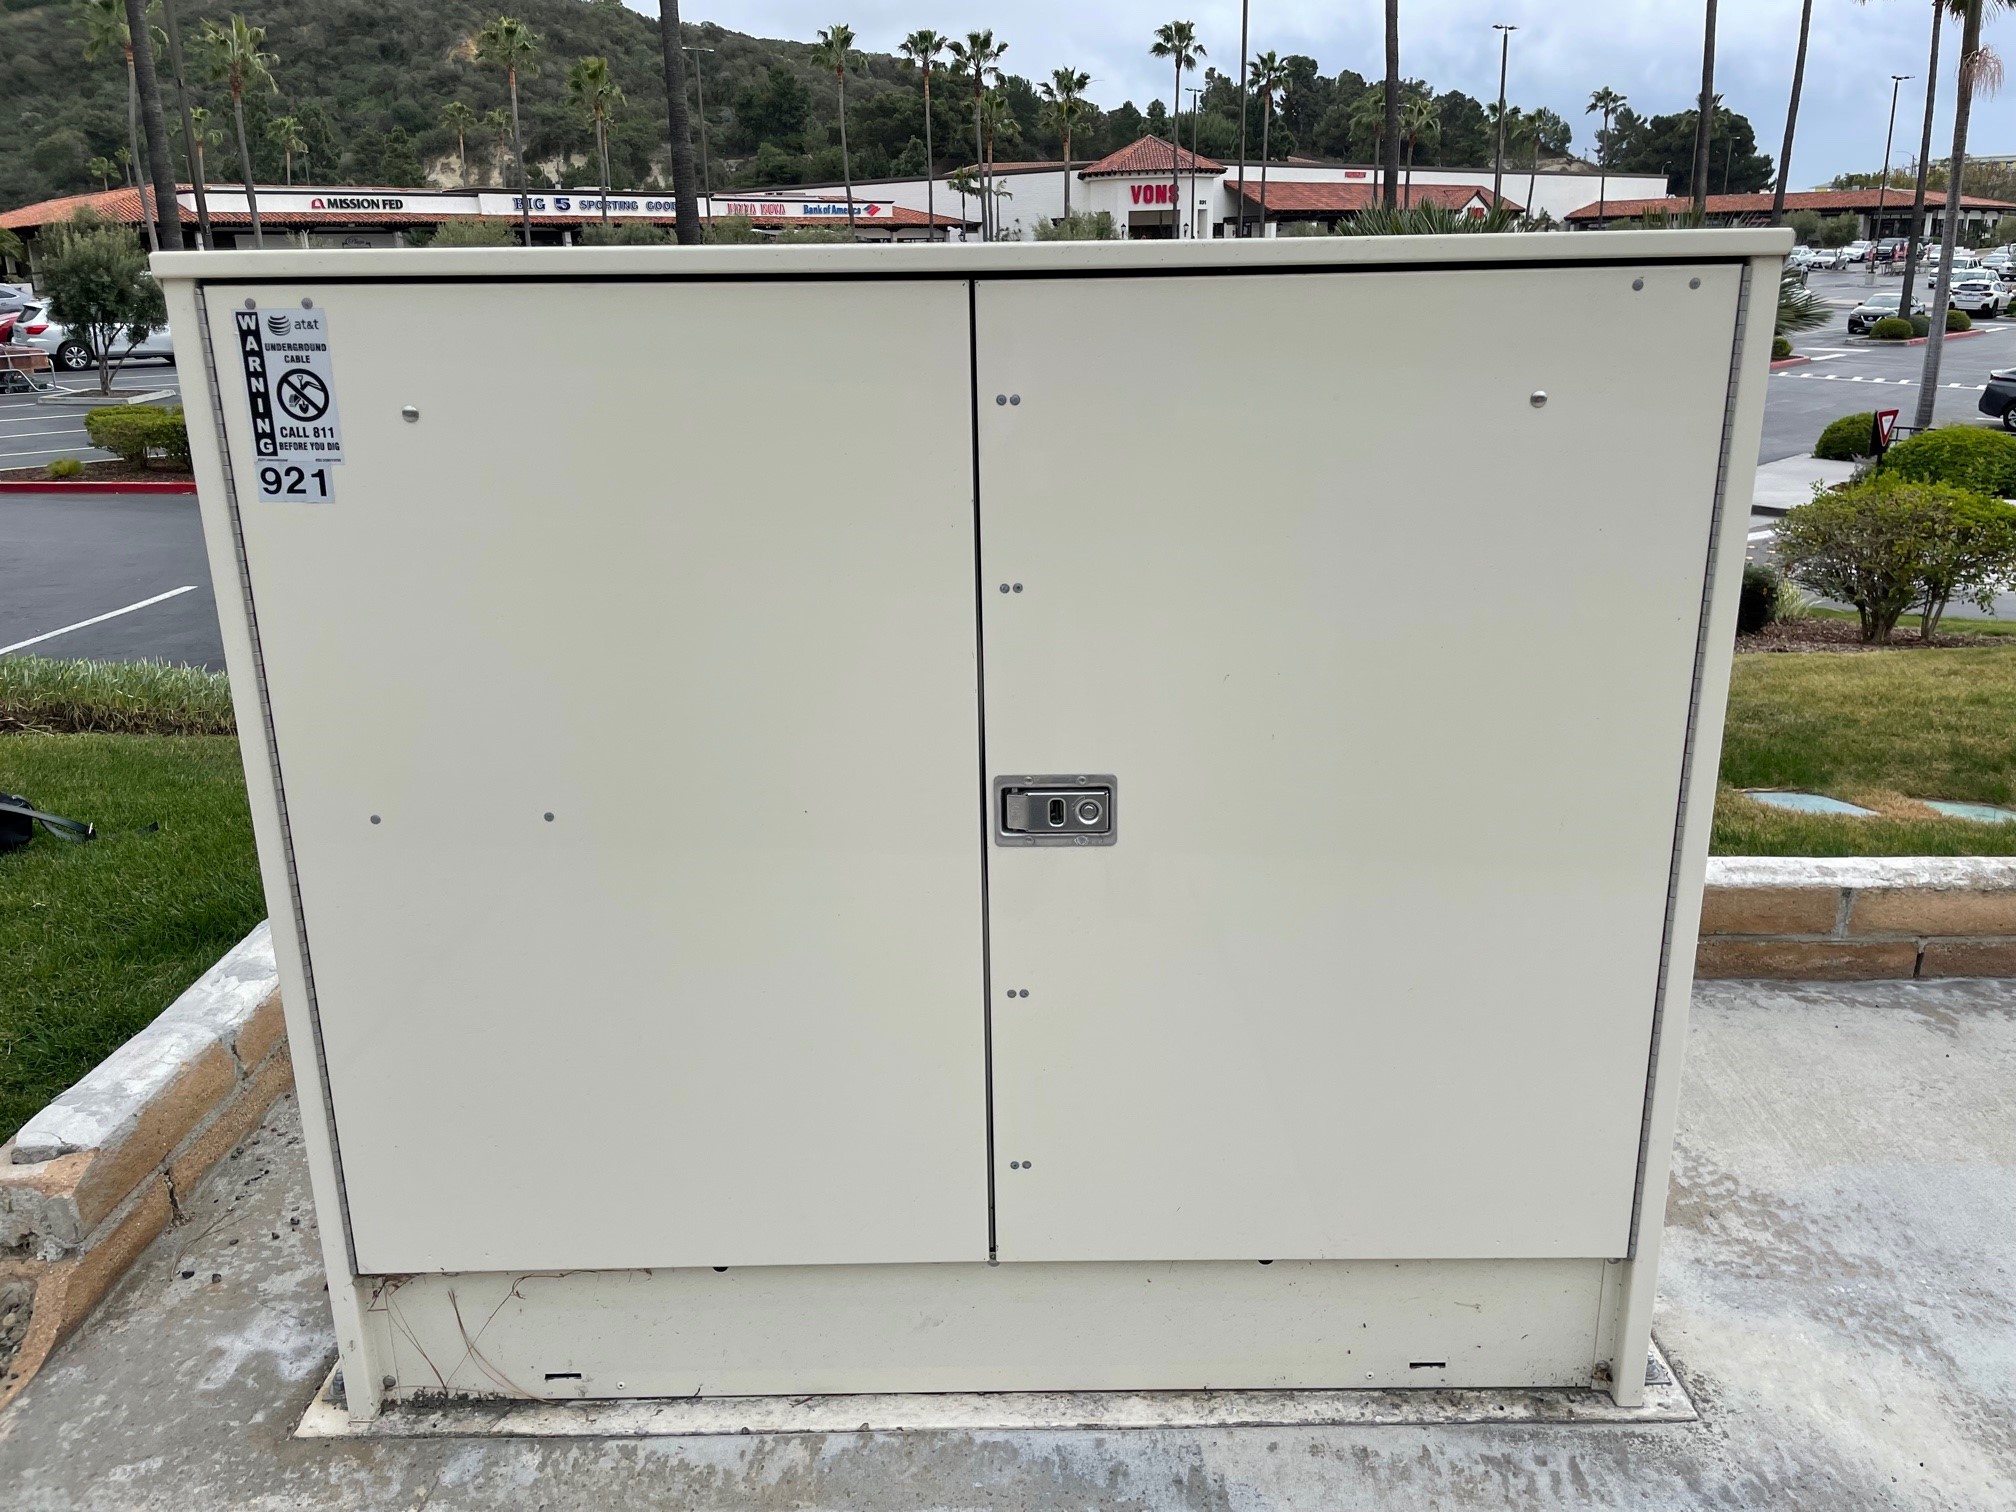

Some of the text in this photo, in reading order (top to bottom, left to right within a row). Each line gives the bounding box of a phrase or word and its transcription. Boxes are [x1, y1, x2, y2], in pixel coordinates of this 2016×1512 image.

[1130, 184, 1179, 204] VONS
[327, 198, 404, 209] MISSION FED
[513, 197, 546, 211] BIG
[554, 197, 571, 212] 5
[579, 199, 639, 211] SPORTING
[803, 204, 862, 215] Bank of Ameca
[294, 319, 319, 330] at&t
[264, 343, 327, 352] UNDERGROUND
[284, 355, 311, 364] CABLE
[237, 315, 274, 453] WARNING
[280, 426, 334, 438] CALL 811
[279, 442, 340, 451] BEFORE YOU DIG
[260, 466, 327, 496] 921
